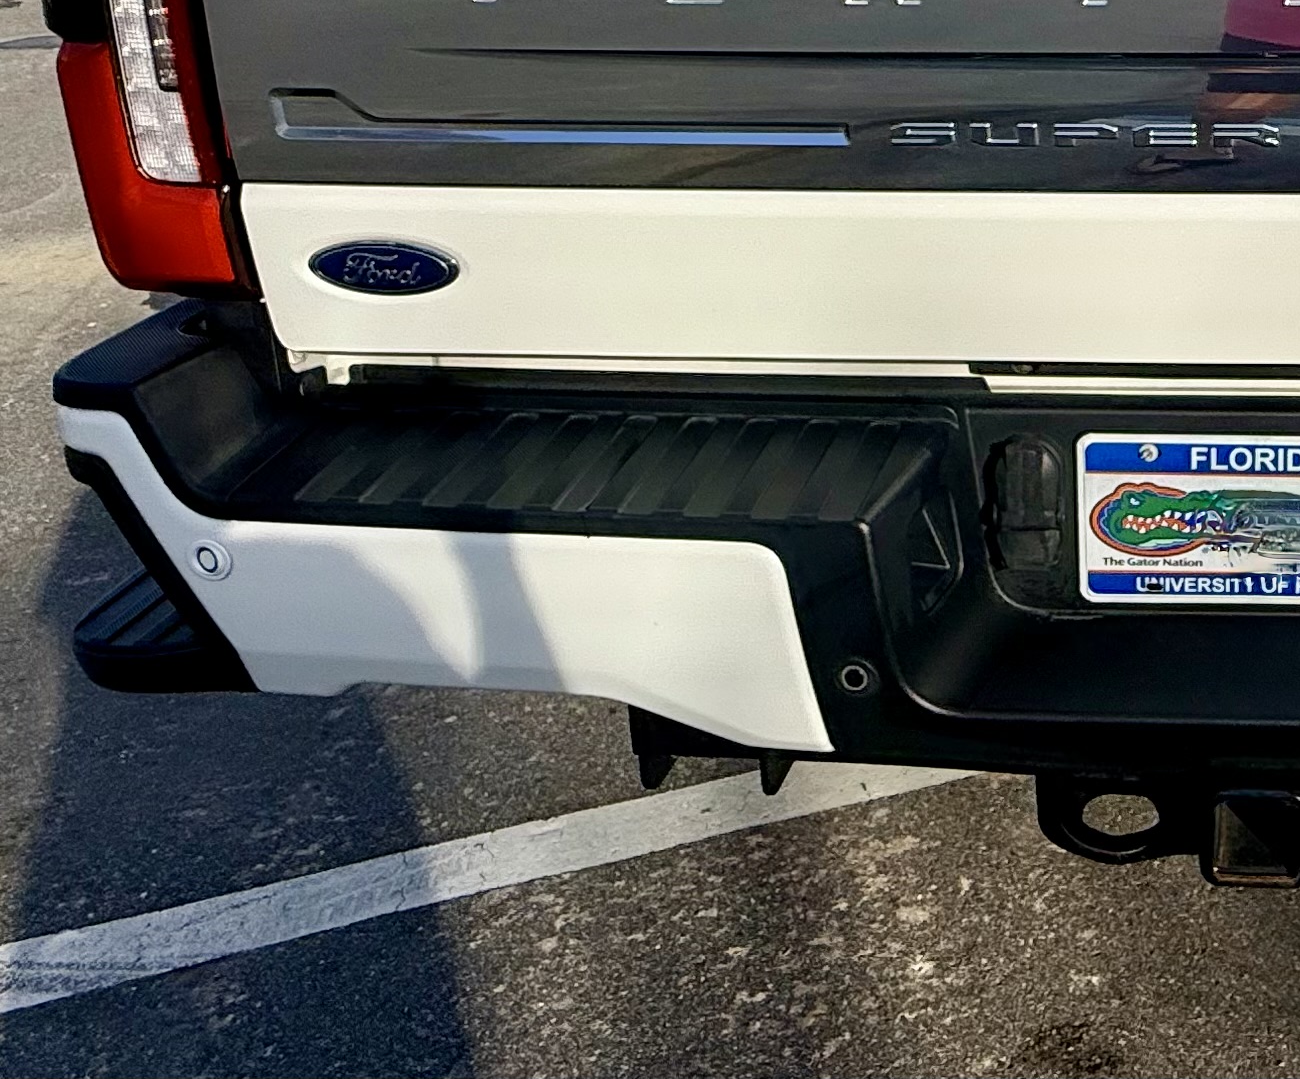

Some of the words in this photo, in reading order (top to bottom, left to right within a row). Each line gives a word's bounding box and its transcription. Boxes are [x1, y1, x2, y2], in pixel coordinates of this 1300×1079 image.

[890, 121, 1280, 148] SUPER
[343, 252, 422, 285] Ford
[1103, 556, 1125, 566] The
[1127, 557, 1160, 567] Gator
[1162, 558, 1204, 567] Nation
